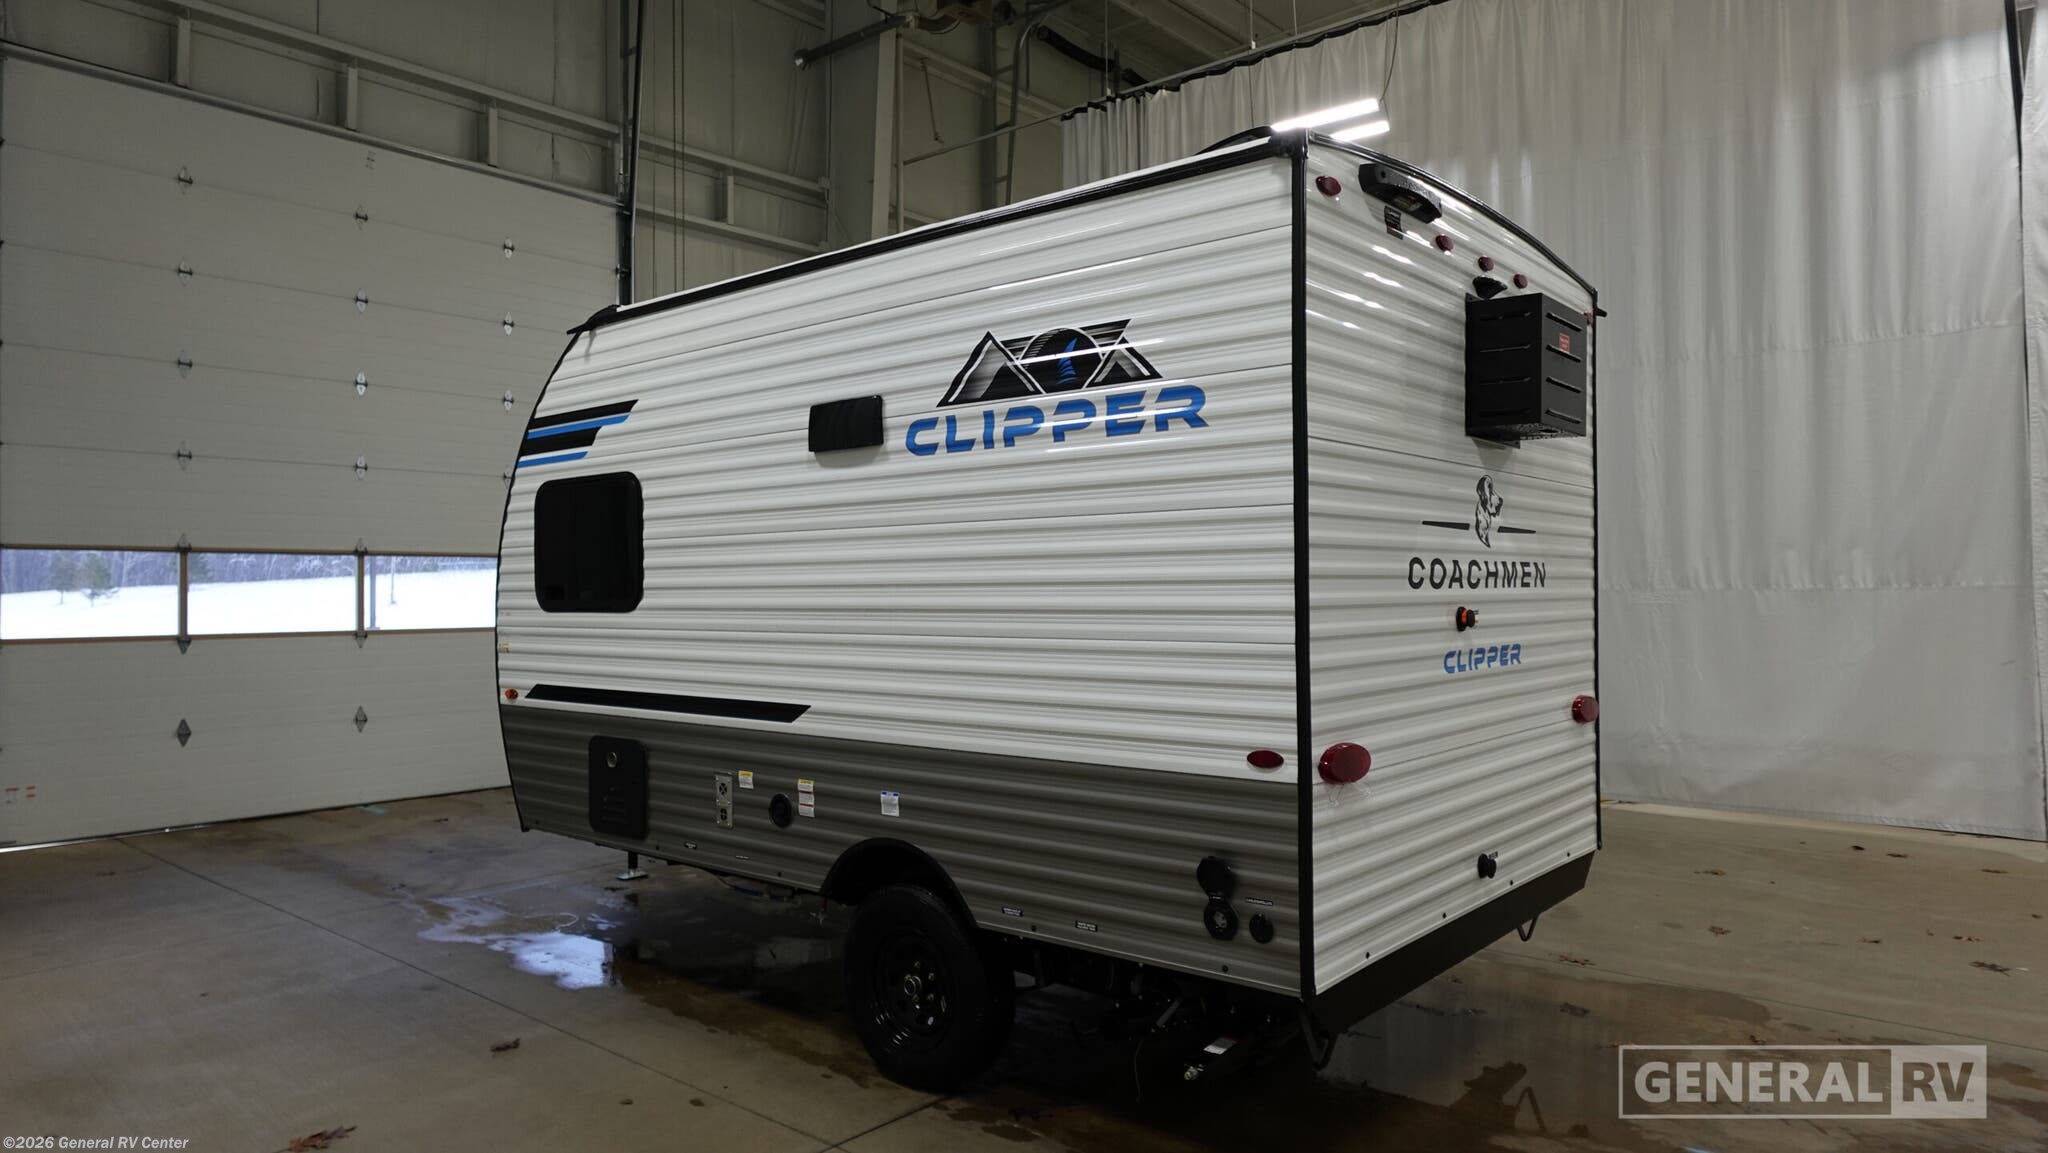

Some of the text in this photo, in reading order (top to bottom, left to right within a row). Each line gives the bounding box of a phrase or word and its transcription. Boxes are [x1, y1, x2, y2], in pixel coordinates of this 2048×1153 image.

[905, 384, 1209, 457] CLIPPER
[1407, 556, 1547, 590] COACHMEN
[1443, 643, 1522, 674] CLIPPER
